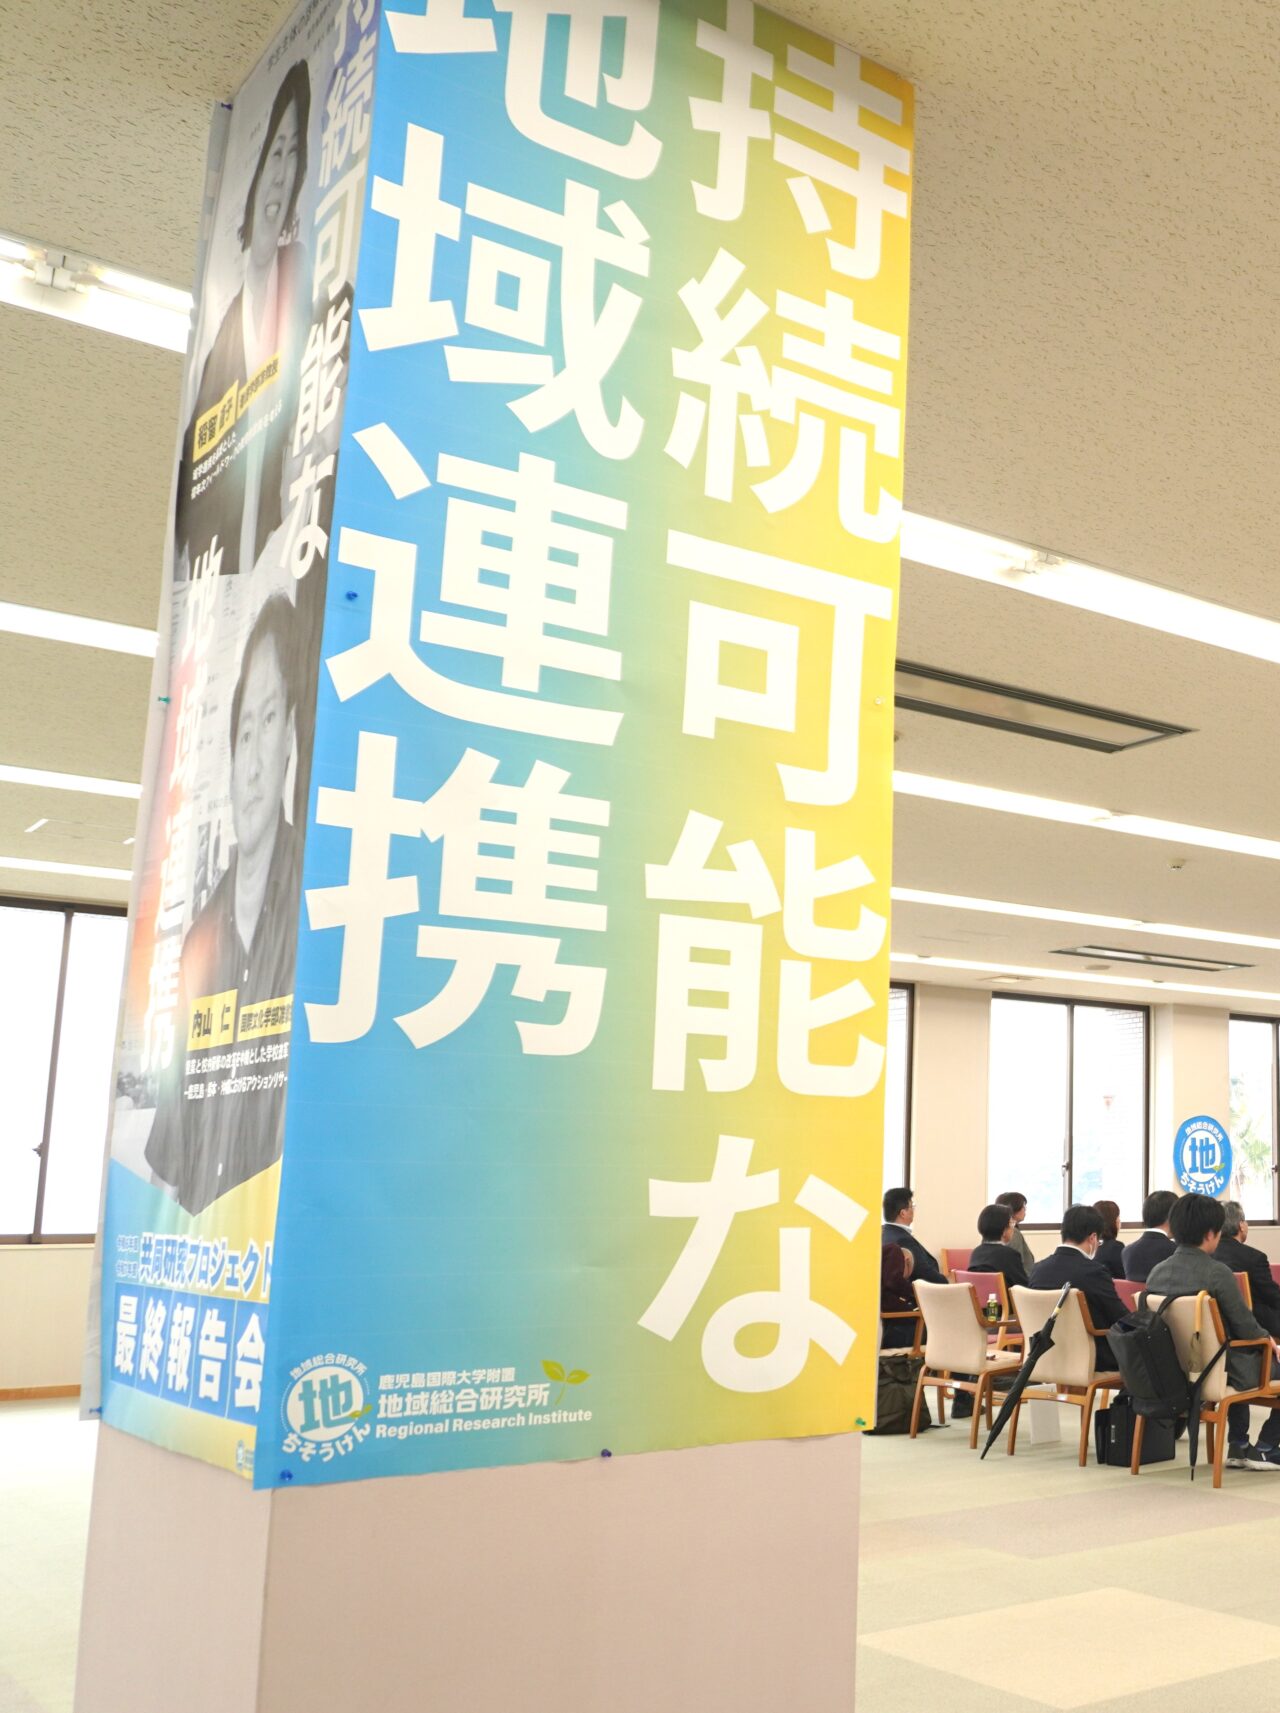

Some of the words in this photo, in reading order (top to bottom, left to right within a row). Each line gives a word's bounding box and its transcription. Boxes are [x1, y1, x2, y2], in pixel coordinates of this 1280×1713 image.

[640, 0, 913, 1393] 持続可能な
[1188, 1136, 1218, 1175] 地
[114, 1294, 266, 1413] 最終報告会
[289, 1352, 368, 1381] 地域総合研究所
[379, 1366, 516, 1391] 鹿児島国際大学附置
[297, 1373, 356, 1435] 地
[376, 1383, 551, 1419] 地域総合研究所
[281, 1422, 371, 1463] ちそうけん
[375, 1420, 449, 1440] Regional
[452, 1414, 526, 1433] Research
[528, 1408, 593, 1428] Institute
